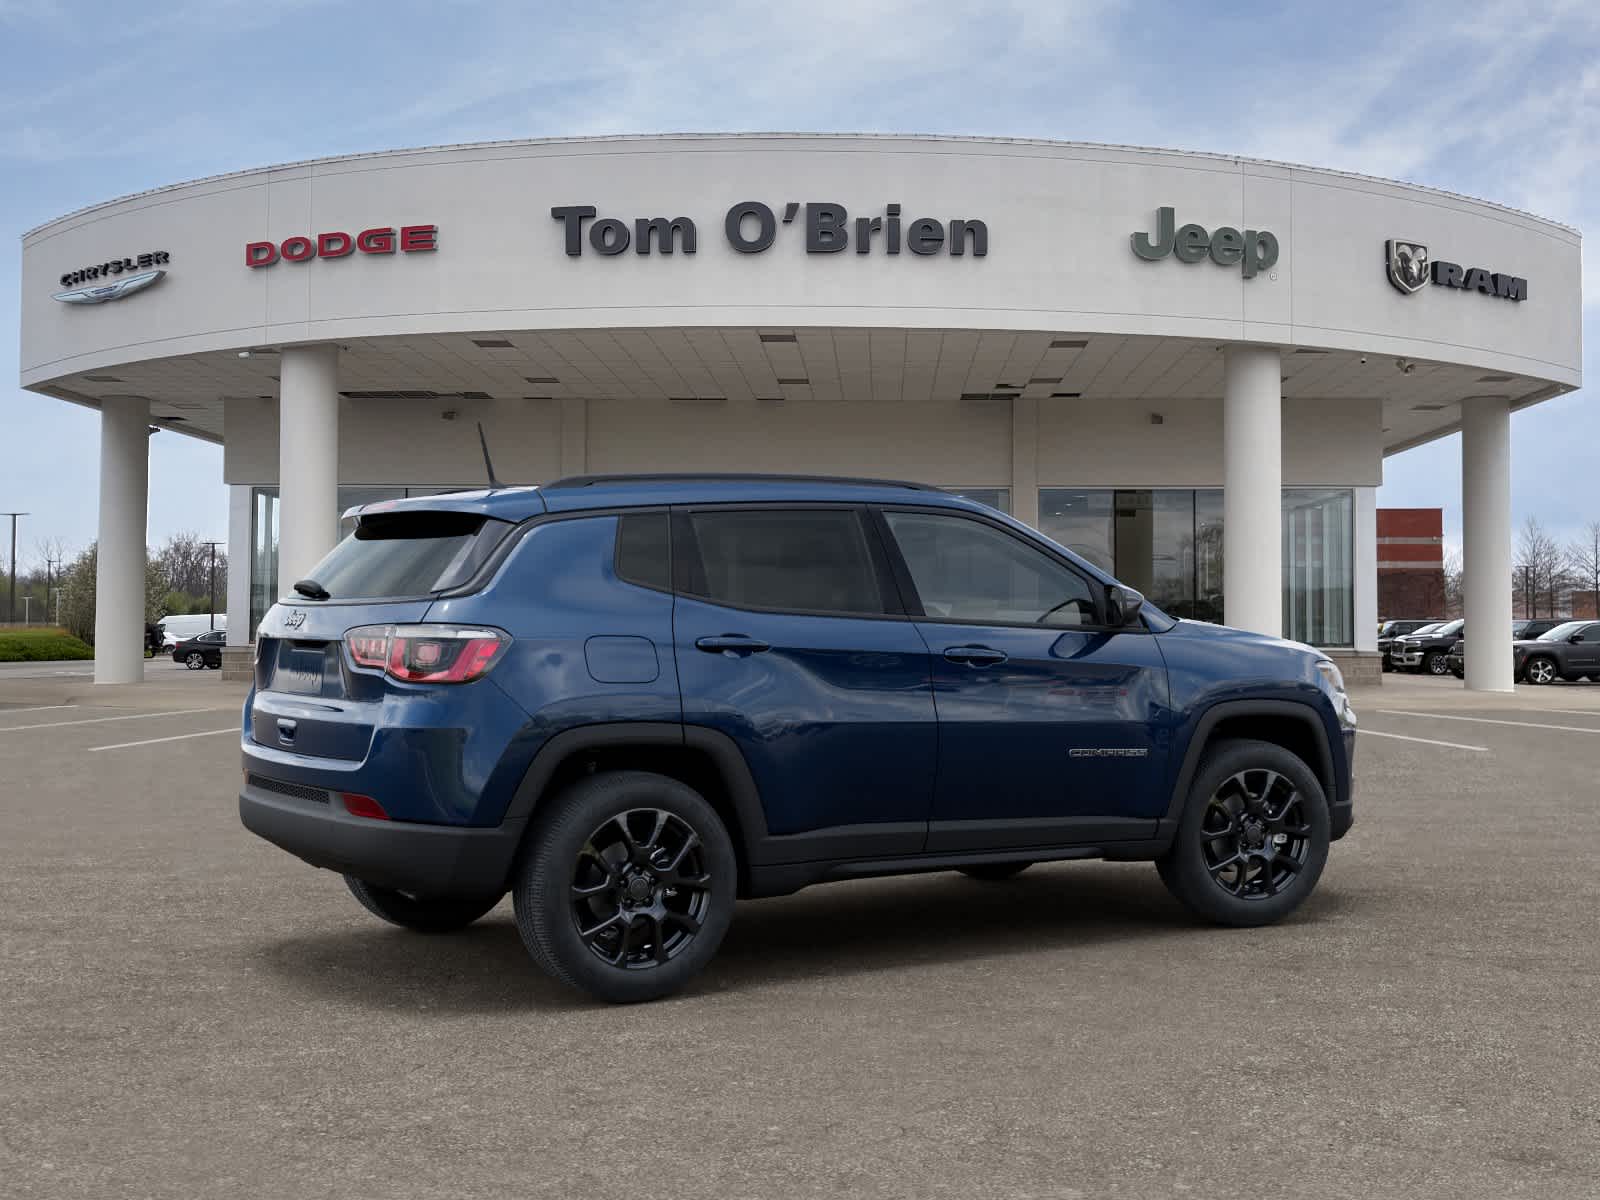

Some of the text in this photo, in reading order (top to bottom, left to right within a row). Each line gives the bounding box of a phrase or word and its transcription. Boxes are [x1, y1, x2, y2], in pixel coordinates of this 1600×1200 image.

[246, 224, 439, 269] DODGE
[551, 201, 989, 257] Tom O'Brien
[1131, 206, 1279, 279] Jeep
[61, 250, 170, 287] CHRYSLER
[1431, 261, 1527, 301] RAM
[1068, 748, 1149, 758] COMPASS
